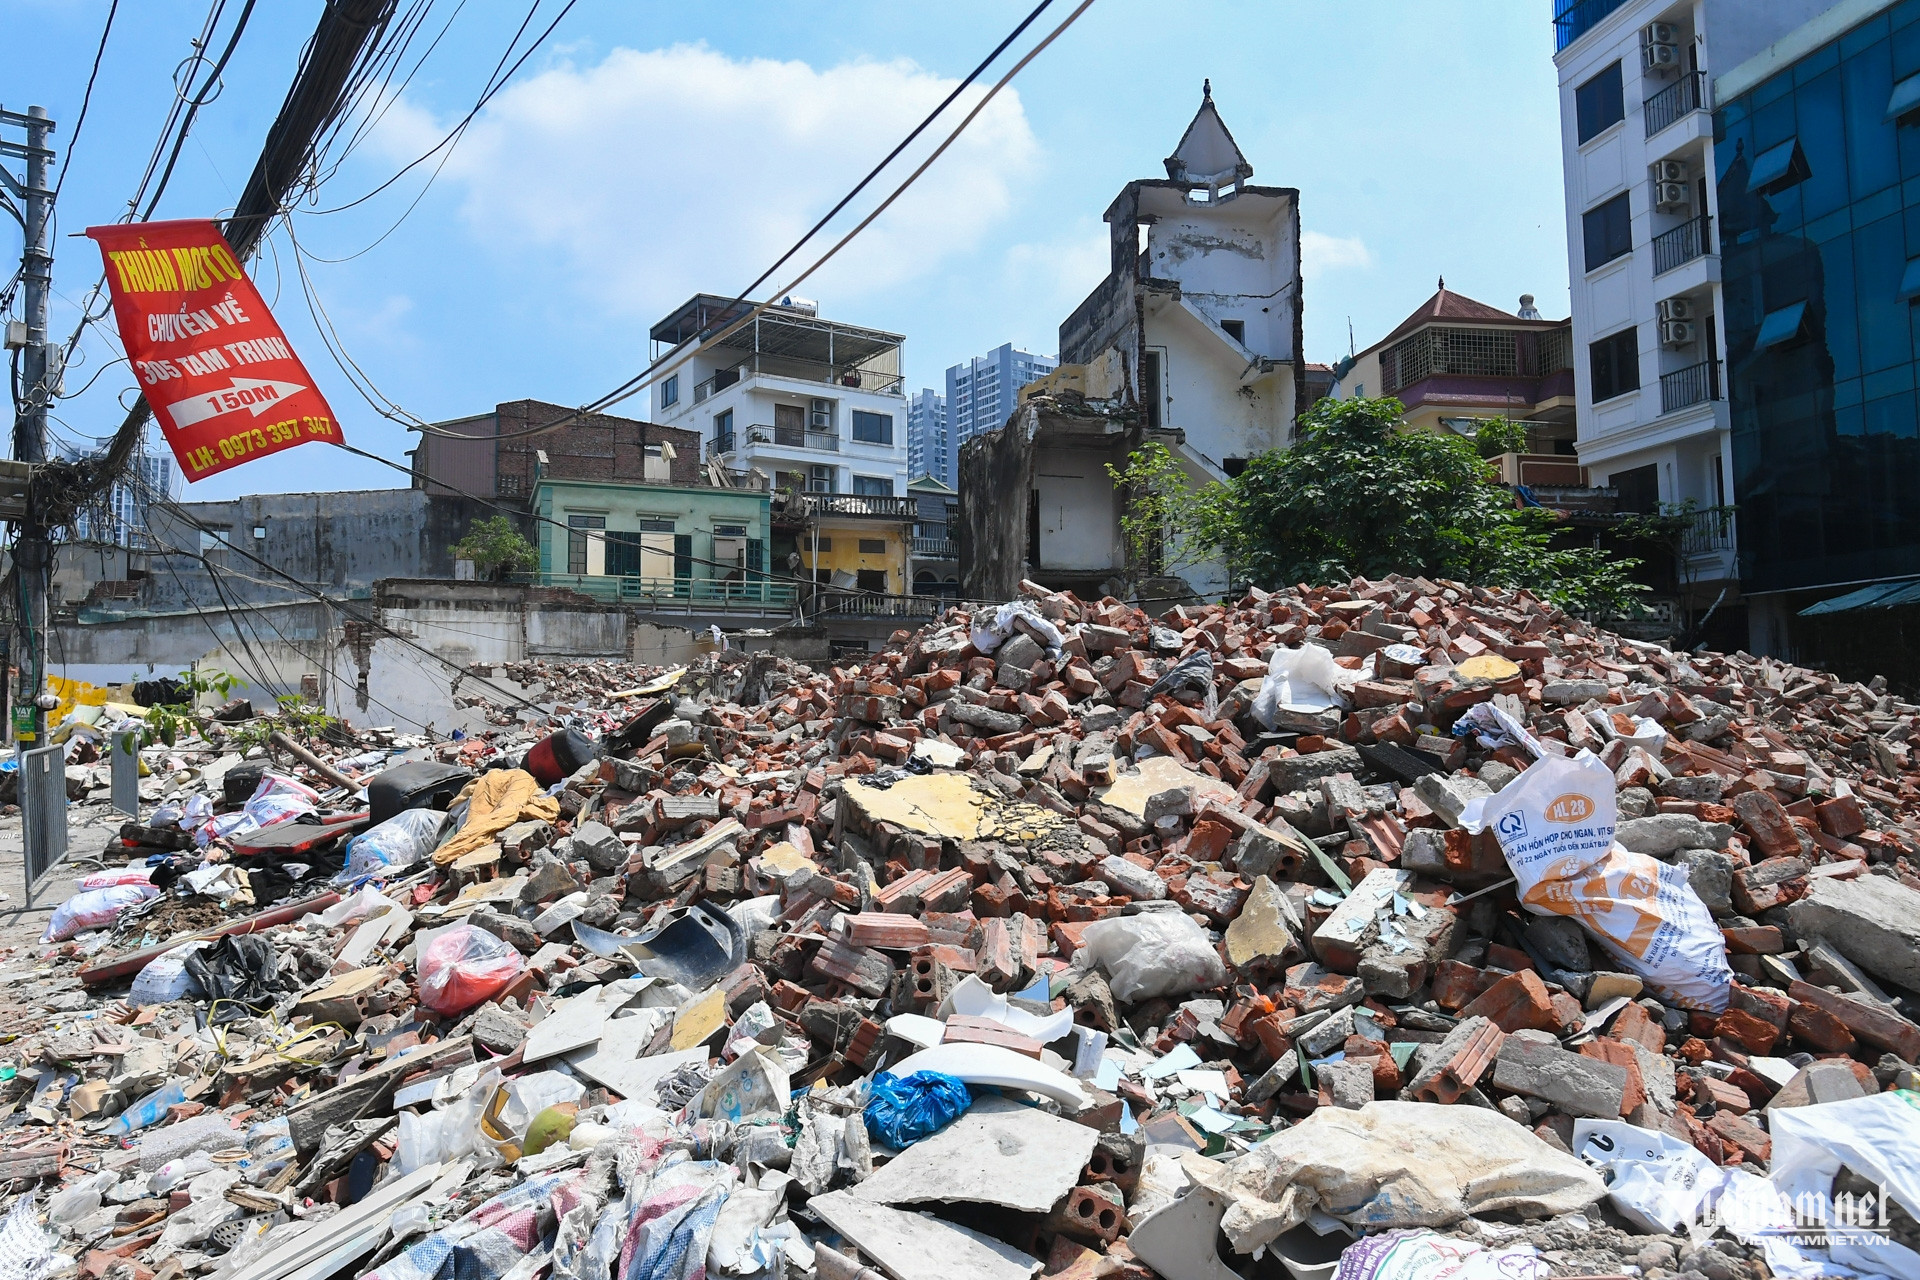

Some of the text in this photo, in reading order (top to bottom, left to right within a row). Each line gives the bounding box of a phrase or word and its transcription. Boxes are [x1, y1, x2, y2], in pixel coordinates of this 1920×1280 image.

[171, 244, 242, 291] MOTO
[148, 292, 250, 342] CHUYỂN VỀ
[137, 337, 292, 385] 305 TAM TRINH
[207, 385, 280, 413] 150M
[186, 416, 332, 472] LH: 0973 397 347
[15, 707, 32, 715] VAY
[1553, 800, 1586, 818] HL 28
[1545, 832, 1559, 845] HỢP
[1561, 830, 1573, 840] CHO
[1574, 828, 1596, 838] NGAN,
